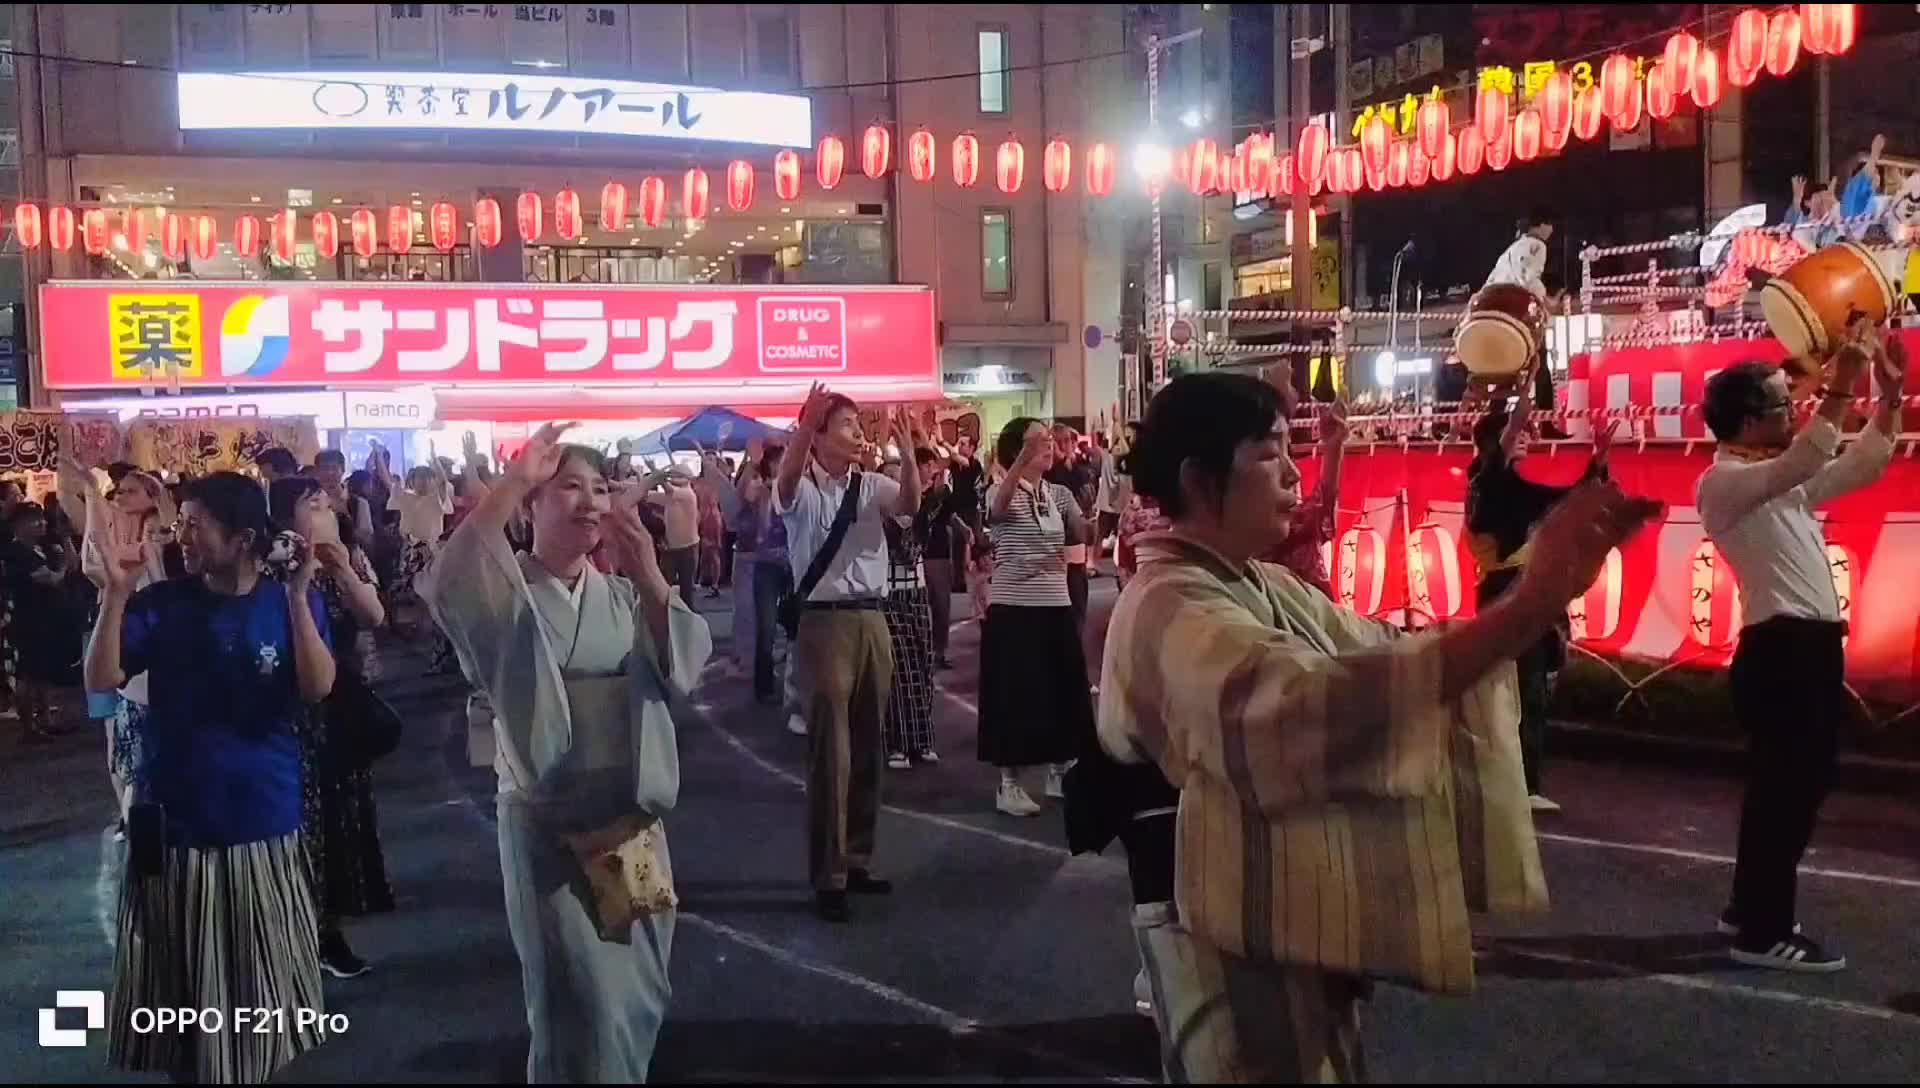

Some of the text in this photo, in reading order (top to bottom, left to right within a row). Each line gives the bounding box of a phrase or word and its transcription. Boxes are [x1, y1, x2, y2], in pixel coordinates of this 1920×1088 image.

[487, 82, 703, 130] ルノアール
[773, 308, 830, 322] DRUG
[118, 301, 192, 369] 薬
[311, 299, 738, 373] サンドラッグ
[797, 326, 809, 341] &
[766, 345, 839, 358] COSMETIC
[354, 403, 420, 417] namco
